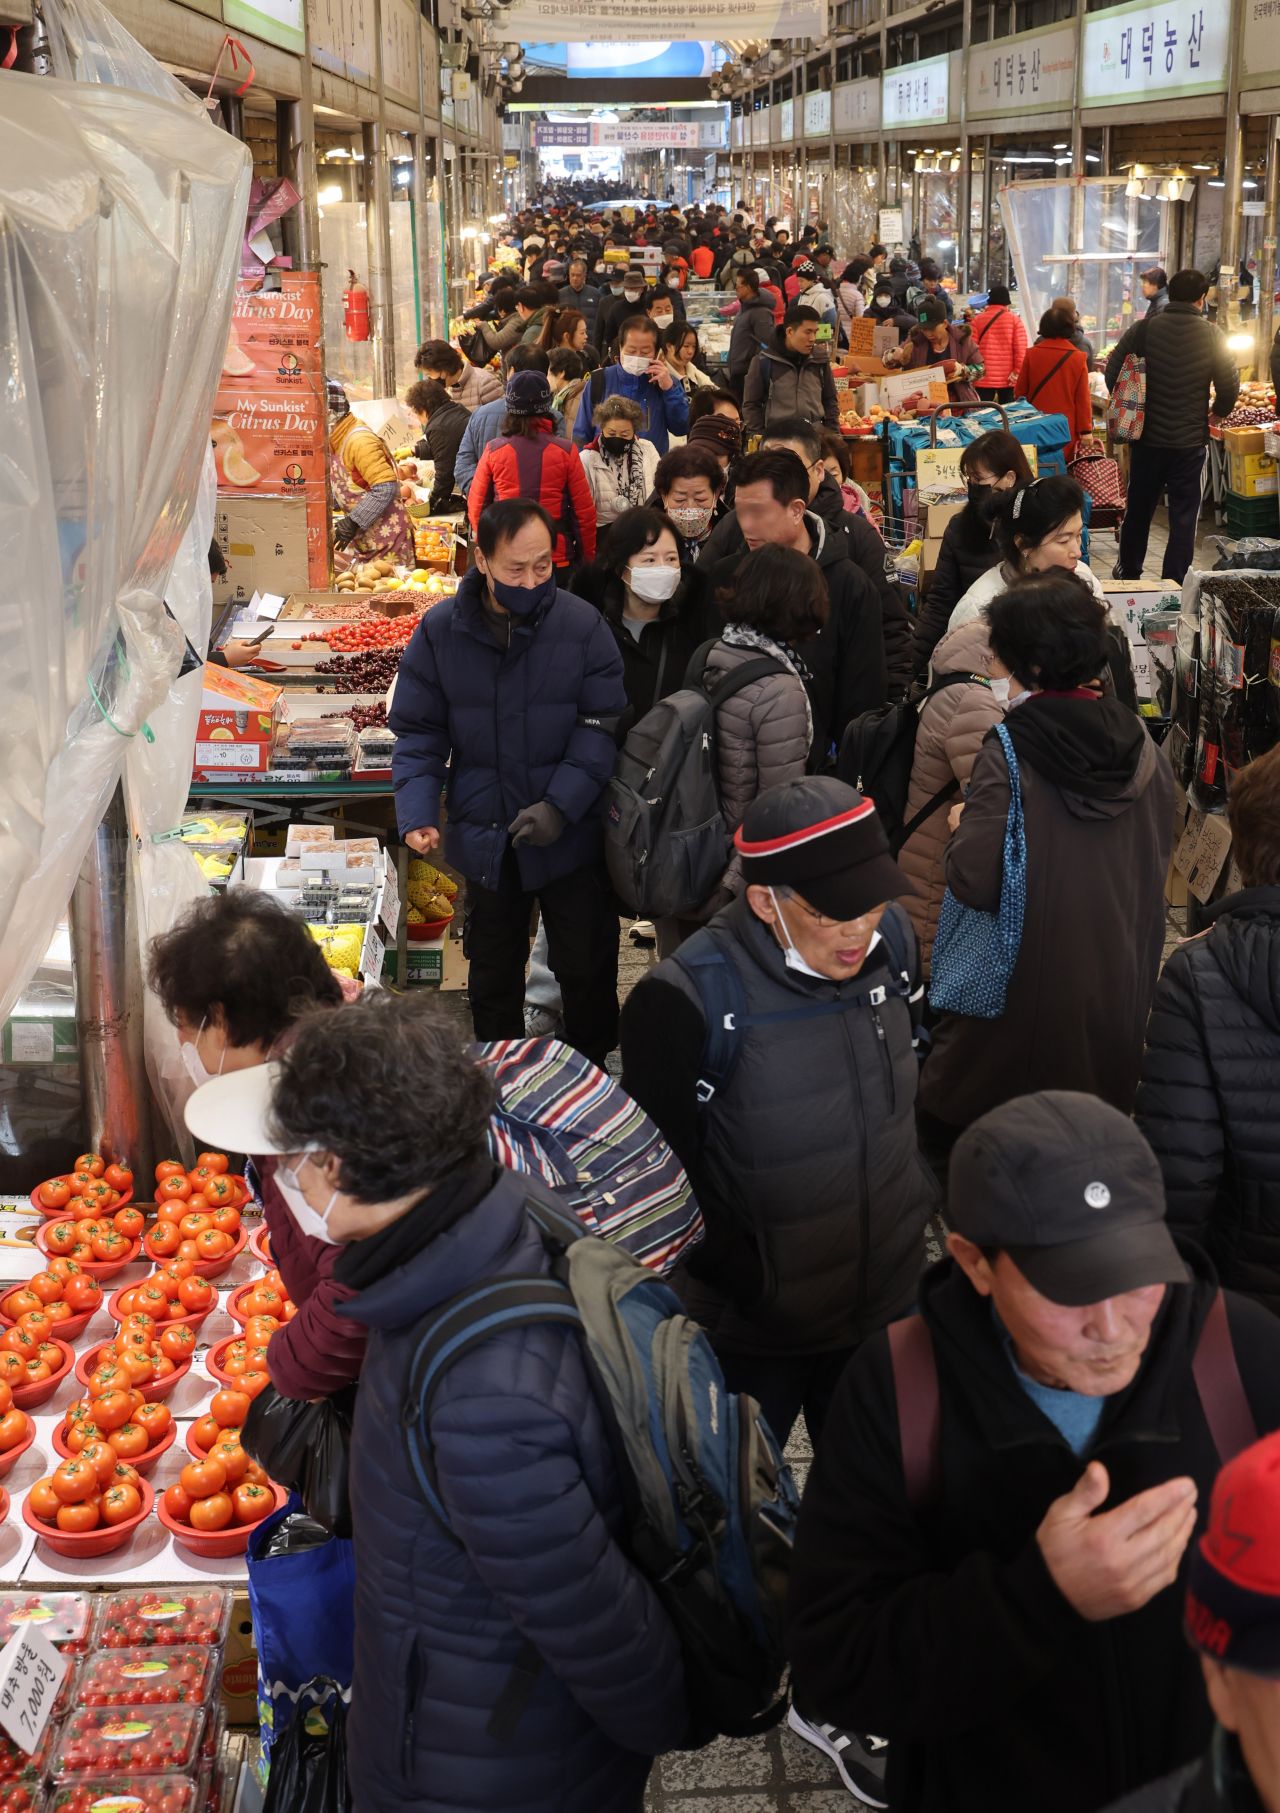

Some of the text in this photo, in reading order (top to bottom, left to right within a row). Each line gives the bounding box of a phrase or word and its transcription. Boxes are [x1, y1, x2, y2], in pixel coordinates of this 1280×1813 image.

[1121, 10, 1204, 80] 대덕농산
[993, 48, 1041, 98] 대덕농산
[279, 301, 313, 323] Day
[275, 376, 303, 385] Sunkist
[237, 399, 305, 415] My Sunkist
[227, 412, 318, 433] Citrus Day
